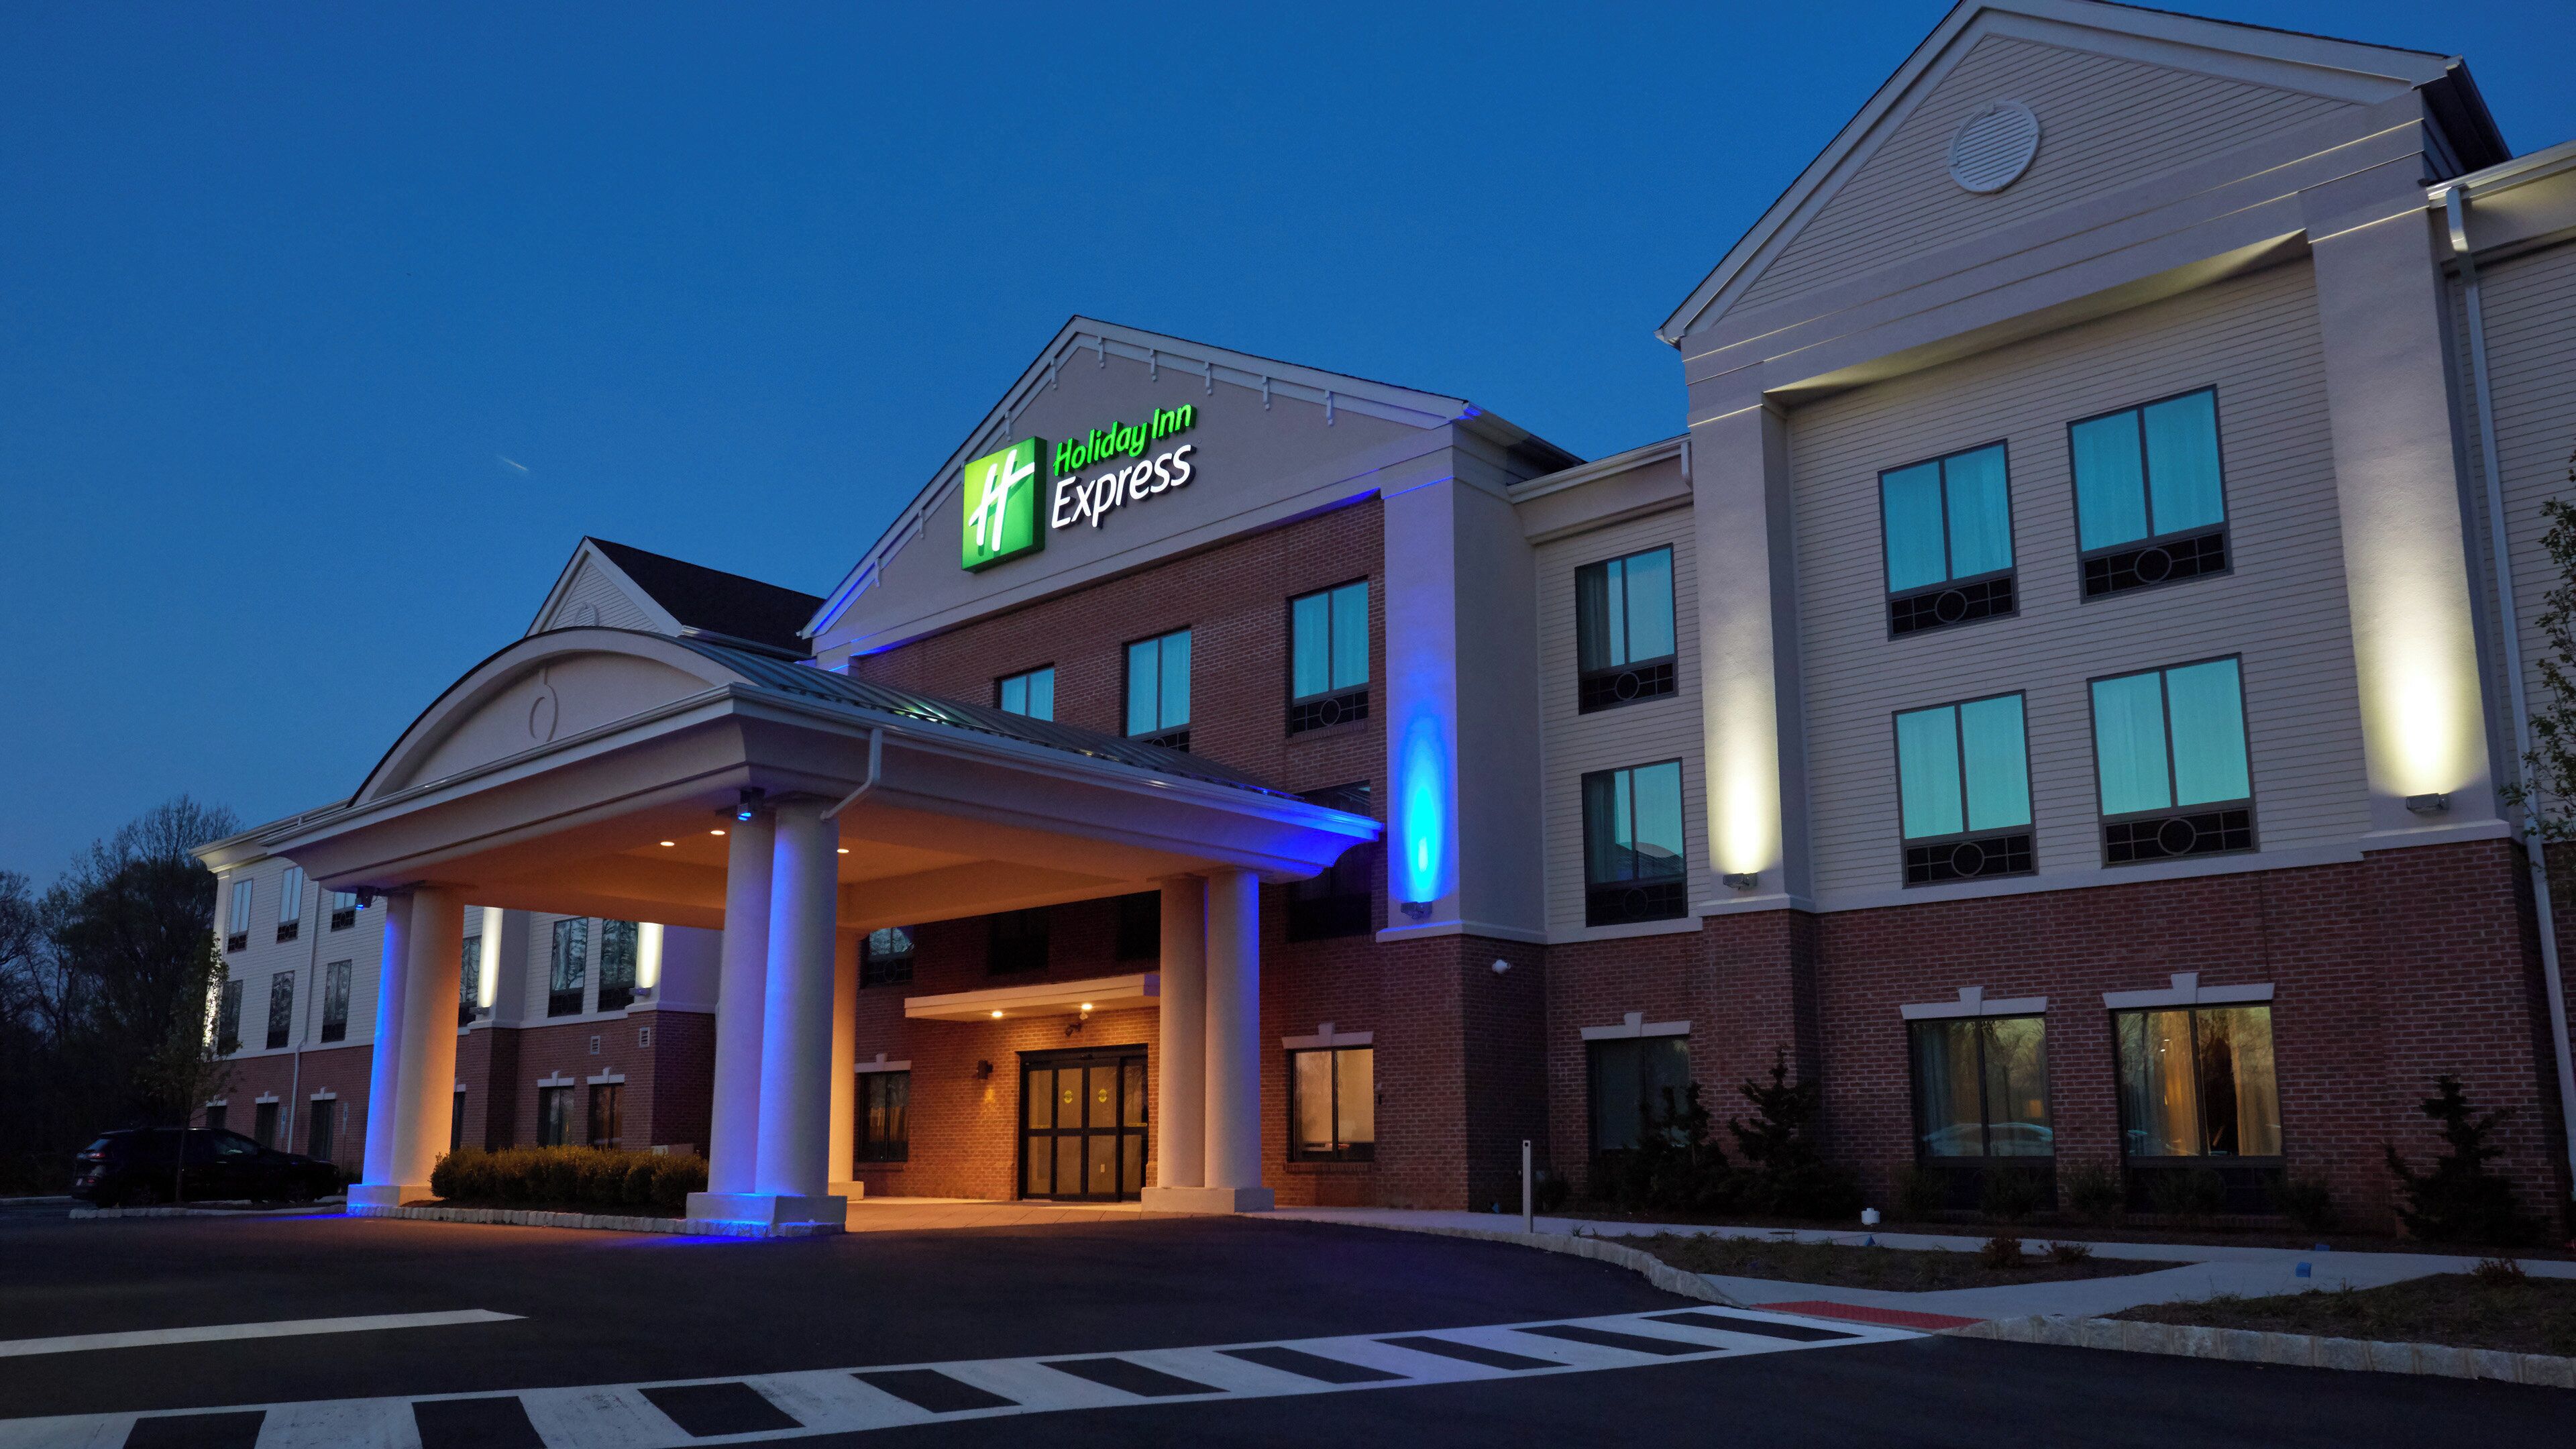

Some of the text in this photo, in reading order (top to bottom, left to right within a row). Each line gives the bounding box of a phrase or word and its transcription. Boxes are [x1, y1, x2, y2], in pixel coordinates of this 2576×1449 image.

[1053, 404, 1192, 476] Holiday Inn
[1051, 444, 1191, 529] Express
